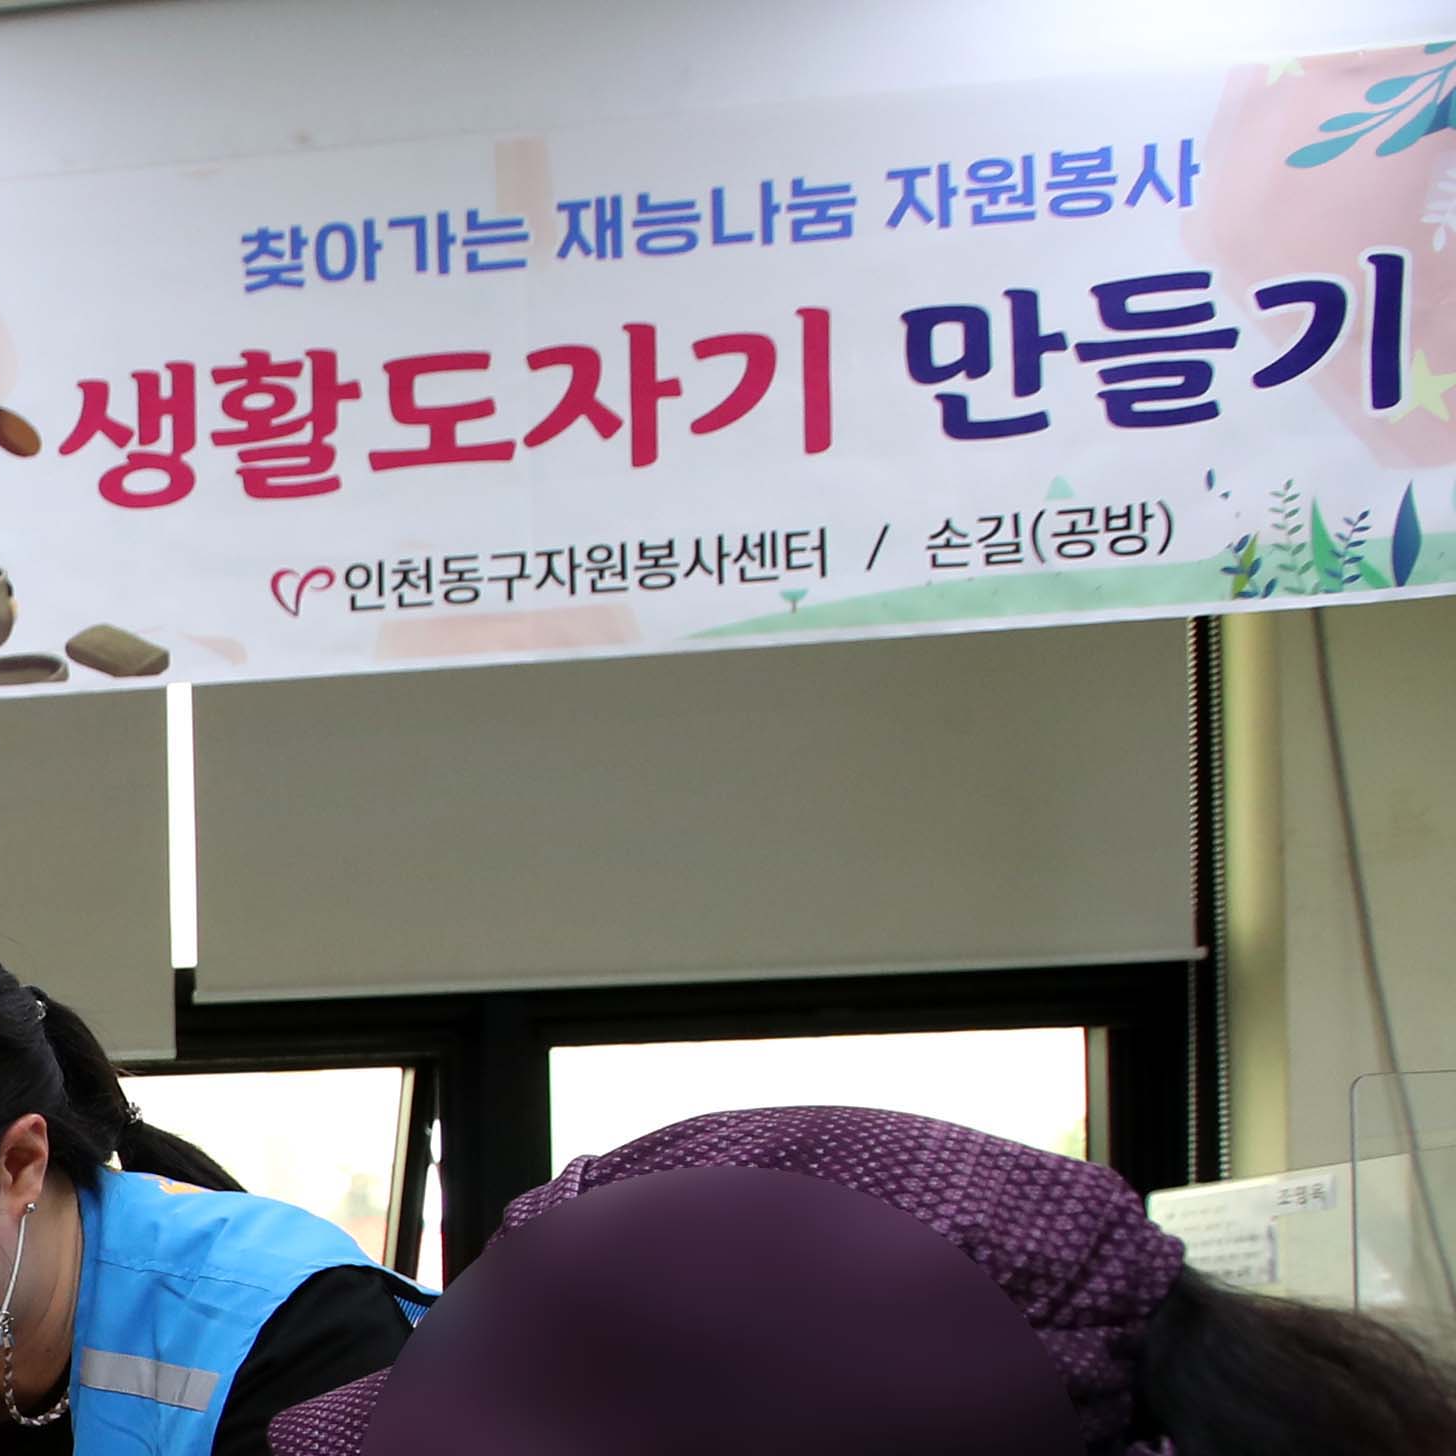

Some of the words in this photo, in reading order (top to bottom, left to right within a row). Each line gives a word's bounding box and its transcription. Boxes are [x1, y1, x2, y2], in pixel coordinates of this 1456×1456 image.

[240, 206, 531, 294] 찾아가는
[556, 175, 859, 263] 재능나눔
[886, 137, 1202, 231] 자원봉사
[57, 305, 834, 511] 생활도자기
[900, 250, 1408, 443] 만들기
[344, 526, 828, 614] 인천동구자원봉사센터
[925, 498, 1174, 572] 손길(공방)
